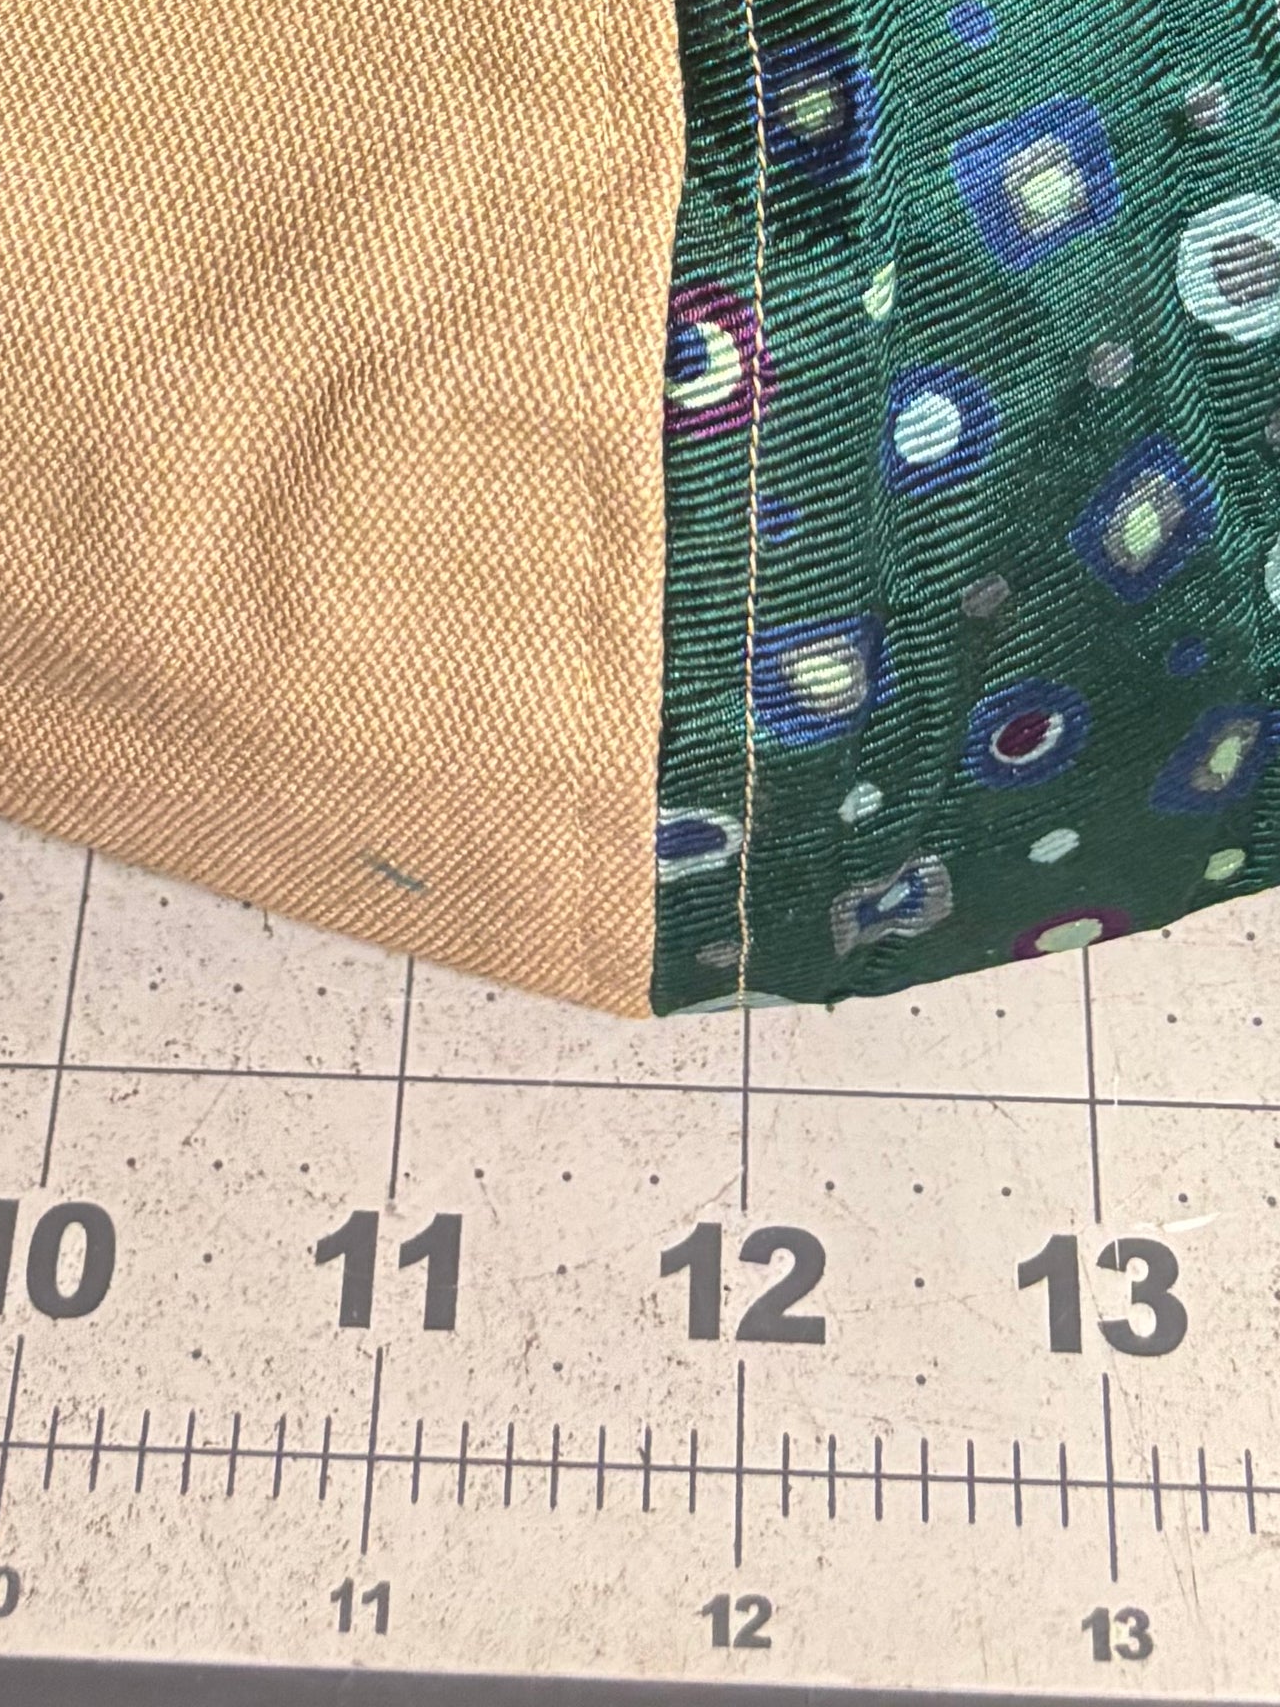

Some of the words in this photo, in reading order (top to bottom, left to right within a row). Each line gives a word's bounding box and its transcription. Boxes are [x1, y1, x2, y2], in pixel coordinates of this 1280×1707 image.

[315, 1209, 462, 1331] 11
[660, 1222, 826, 1344] 12
[1017, 1234, 1188, 1357] 13
[330, 1579, 391, 1635] 11
[698, 1595, 772, 1649] 12
[1081, 1607, 1153, 1662] 13
